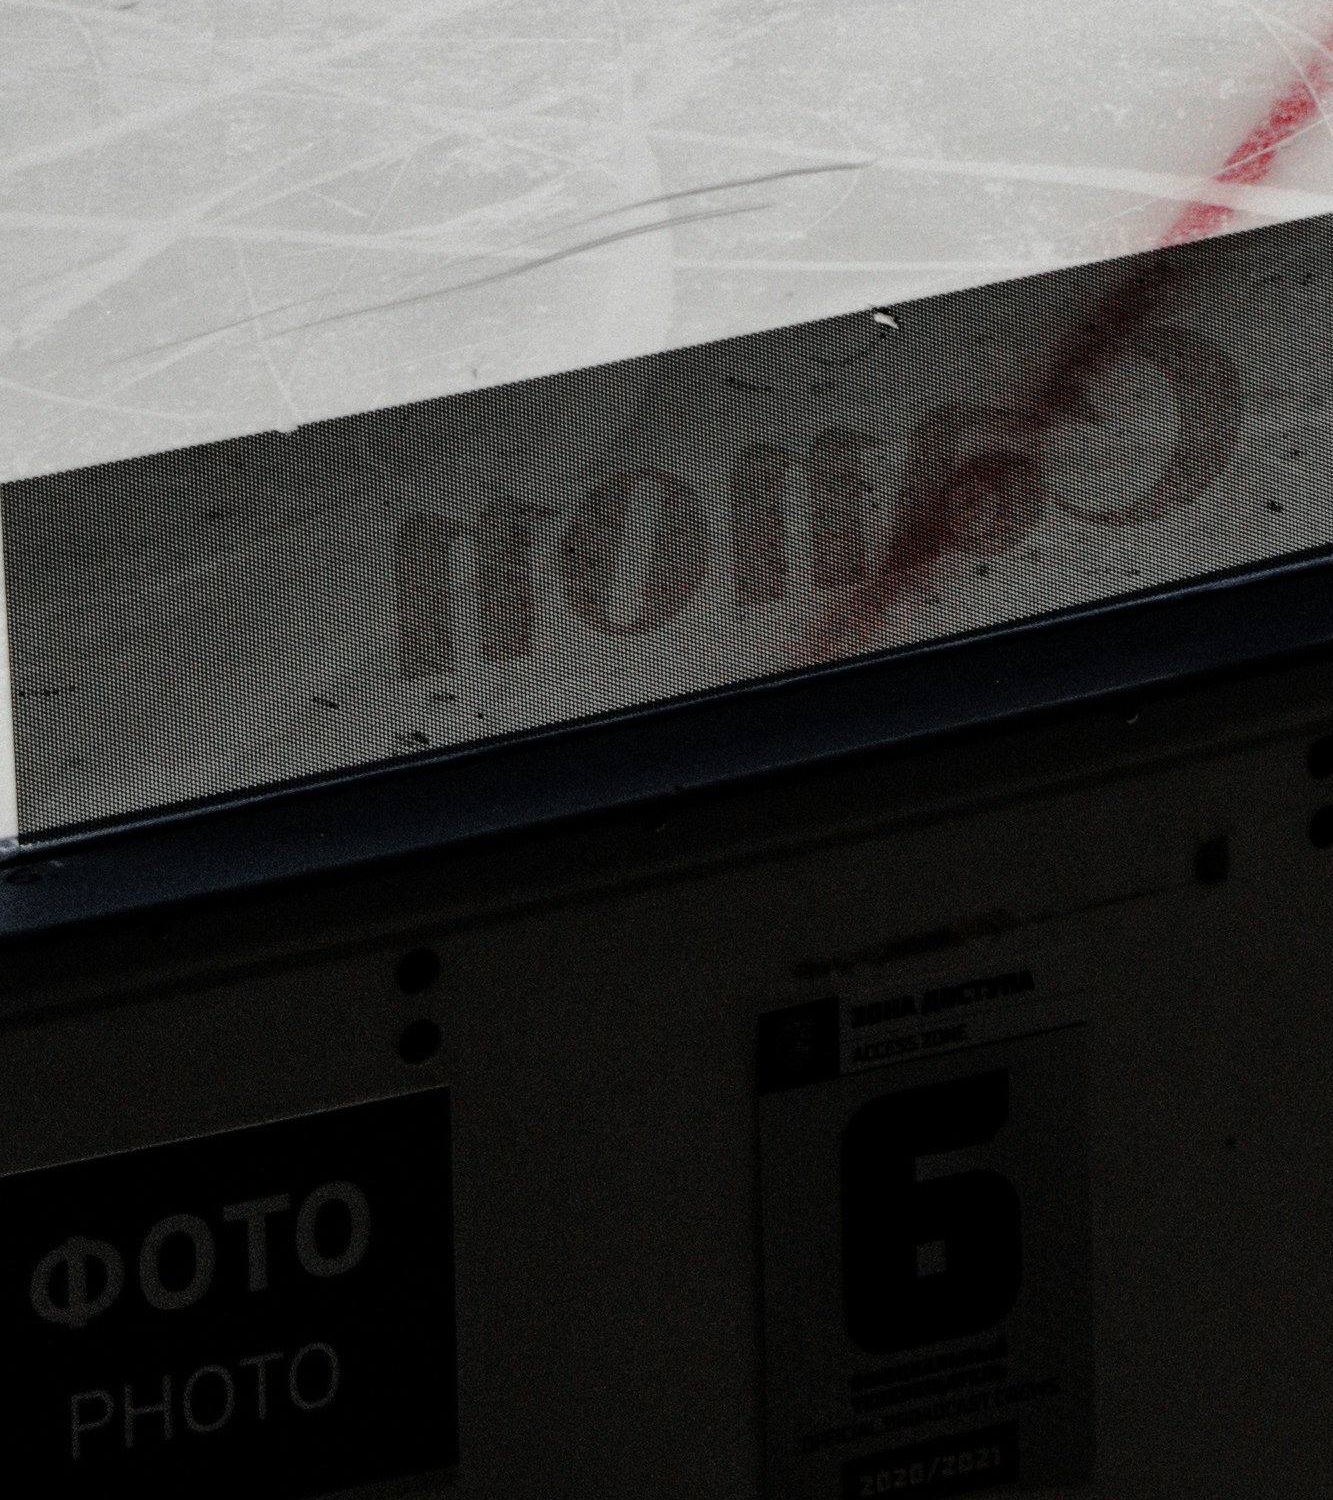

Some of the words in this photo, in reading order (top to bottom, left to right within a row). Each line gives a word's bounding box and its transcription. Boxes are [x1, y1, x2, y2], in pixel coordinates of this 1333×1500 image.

[850, 994, 918, 1029] ЗОНА
[921, 968, 1036, 1017] ДОСТУПА
[852, 1033, 918, 1064] ACCESS
[921, 1023, 968, 1049] ZONE
[838, 1069, 1023, 1356] 6
[29, 1179, 373, 1331] ФОТО
[67, 1341, 341, 1462] PHOTO
[883, 1392, 990, 1434] BROADCAST
[994, 1376, 1061, 1407] CREWS
[859, 1445, 1003, 1498] 2020/2021
